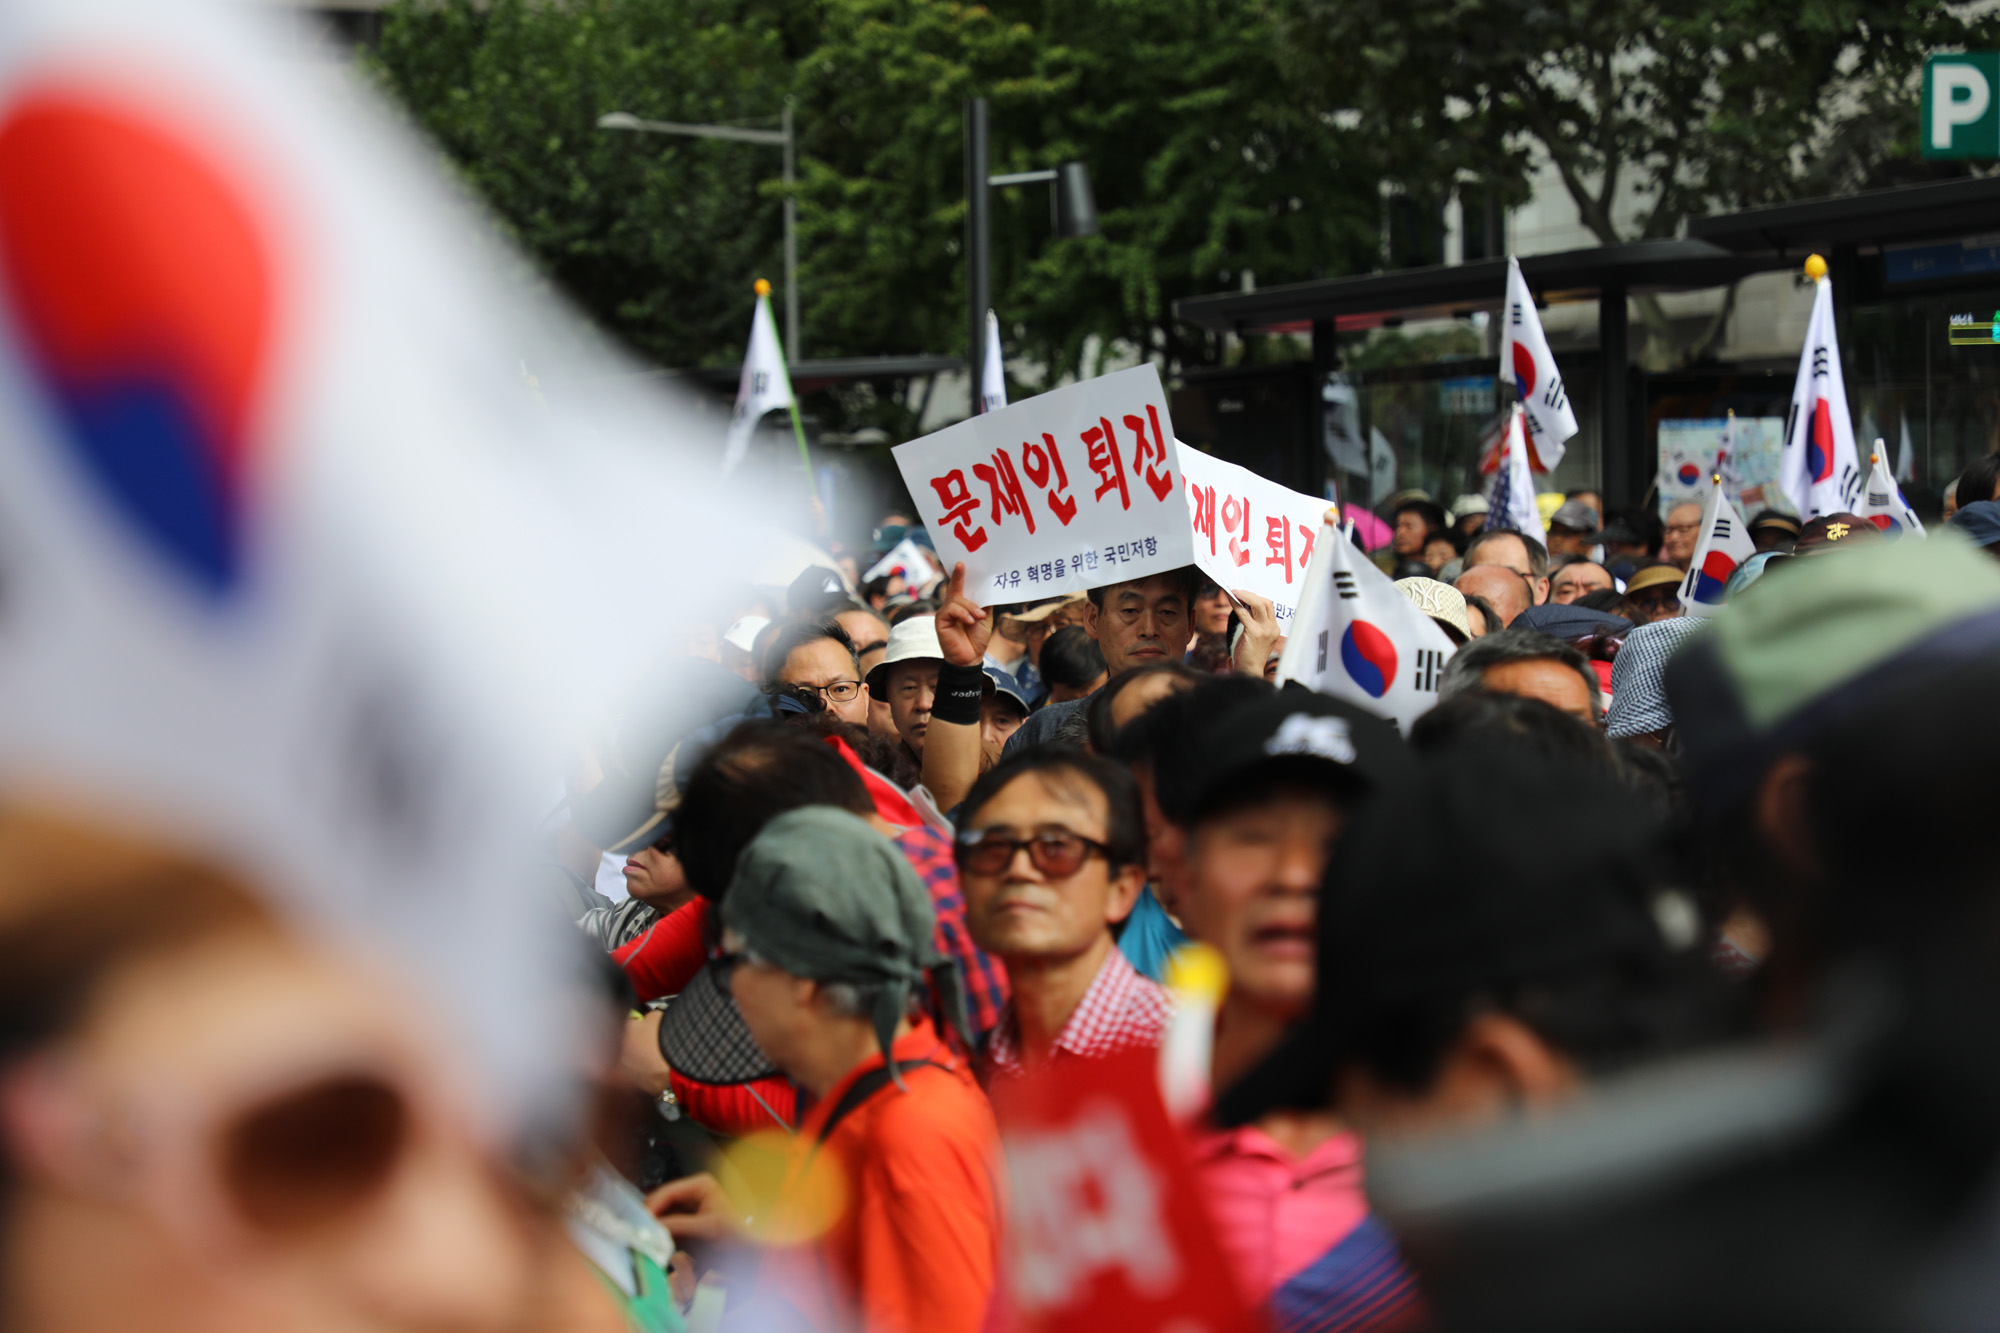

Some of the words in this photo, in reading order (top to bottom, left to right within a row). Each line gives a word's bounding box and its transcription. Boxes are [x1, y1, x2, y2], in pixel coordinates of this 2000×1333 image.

[1931, 63, 1990, 150] P
[930, 432, 1077, 553] 문재인
[1080, 404, 1173, 511] 퇴진
[1182, 474, 1250, 568] 재인
[993, 570, 1022, 589] 자유
[1027, 558, 1067, 584] 혁명을
[1071, 550, 1099, 573] 위한
[1104, 536, 1158, 565] 국민저항
